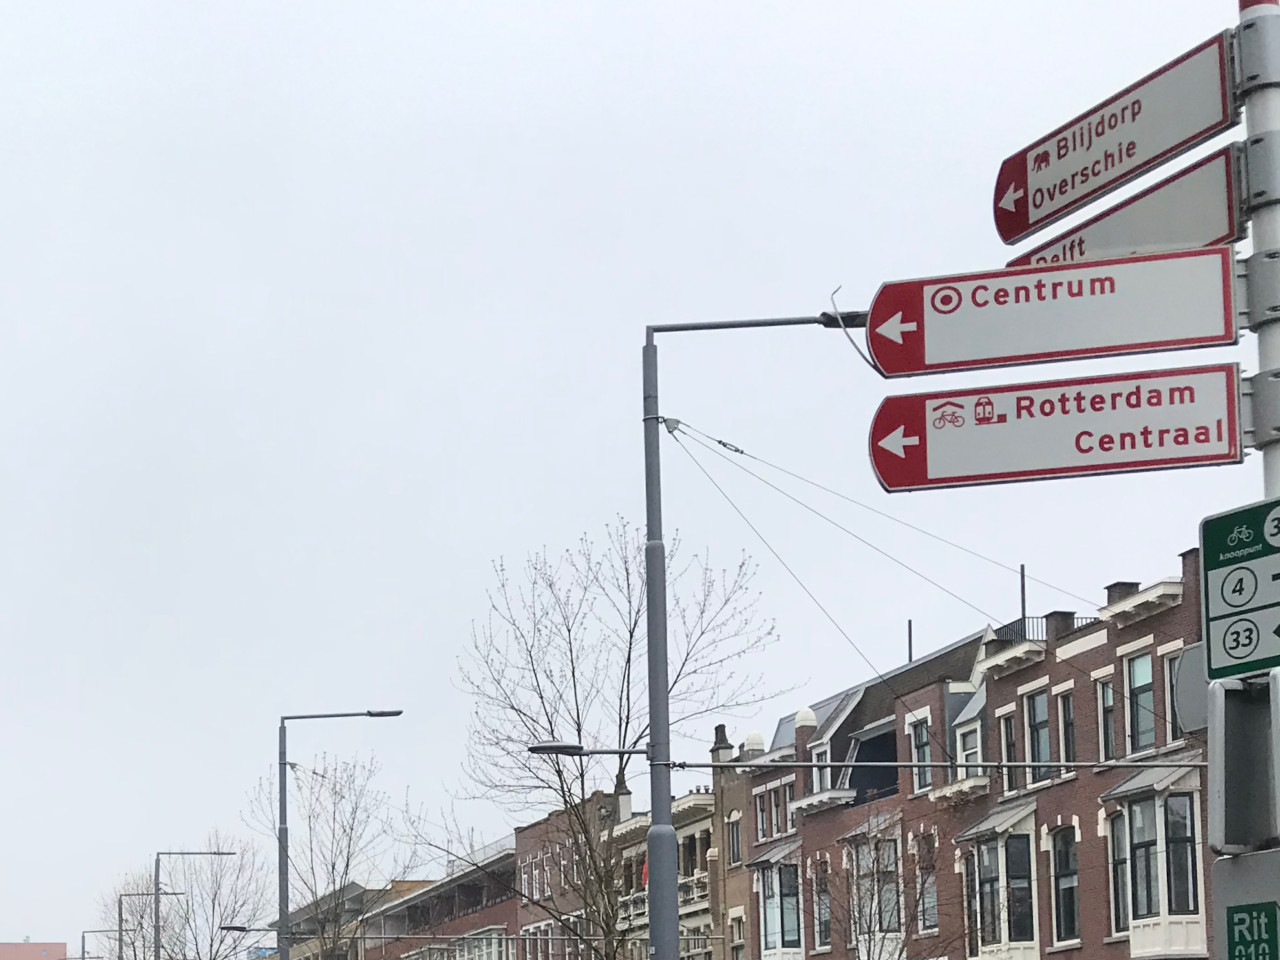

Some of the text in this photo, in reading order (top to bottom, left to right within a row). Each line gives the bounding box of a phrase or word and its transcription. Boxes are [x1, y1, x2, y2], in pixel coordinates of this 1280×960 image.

[1056, 99, 1142, 160] Blijdorp
[1032, 140, 1136, 210] Overschie
[971, 275, 1116, 308] Centrum
[1015, 384, 1196, 419] Rotterdam
[1074, 418, 1223, 454] Centraal
[1219, 544, 1263, 561] knooppunt
[1231, 577, 1245, 596] 4
[1228, 627, 1254, 651] 33
[1233, 911, 1269, 942] Rit
